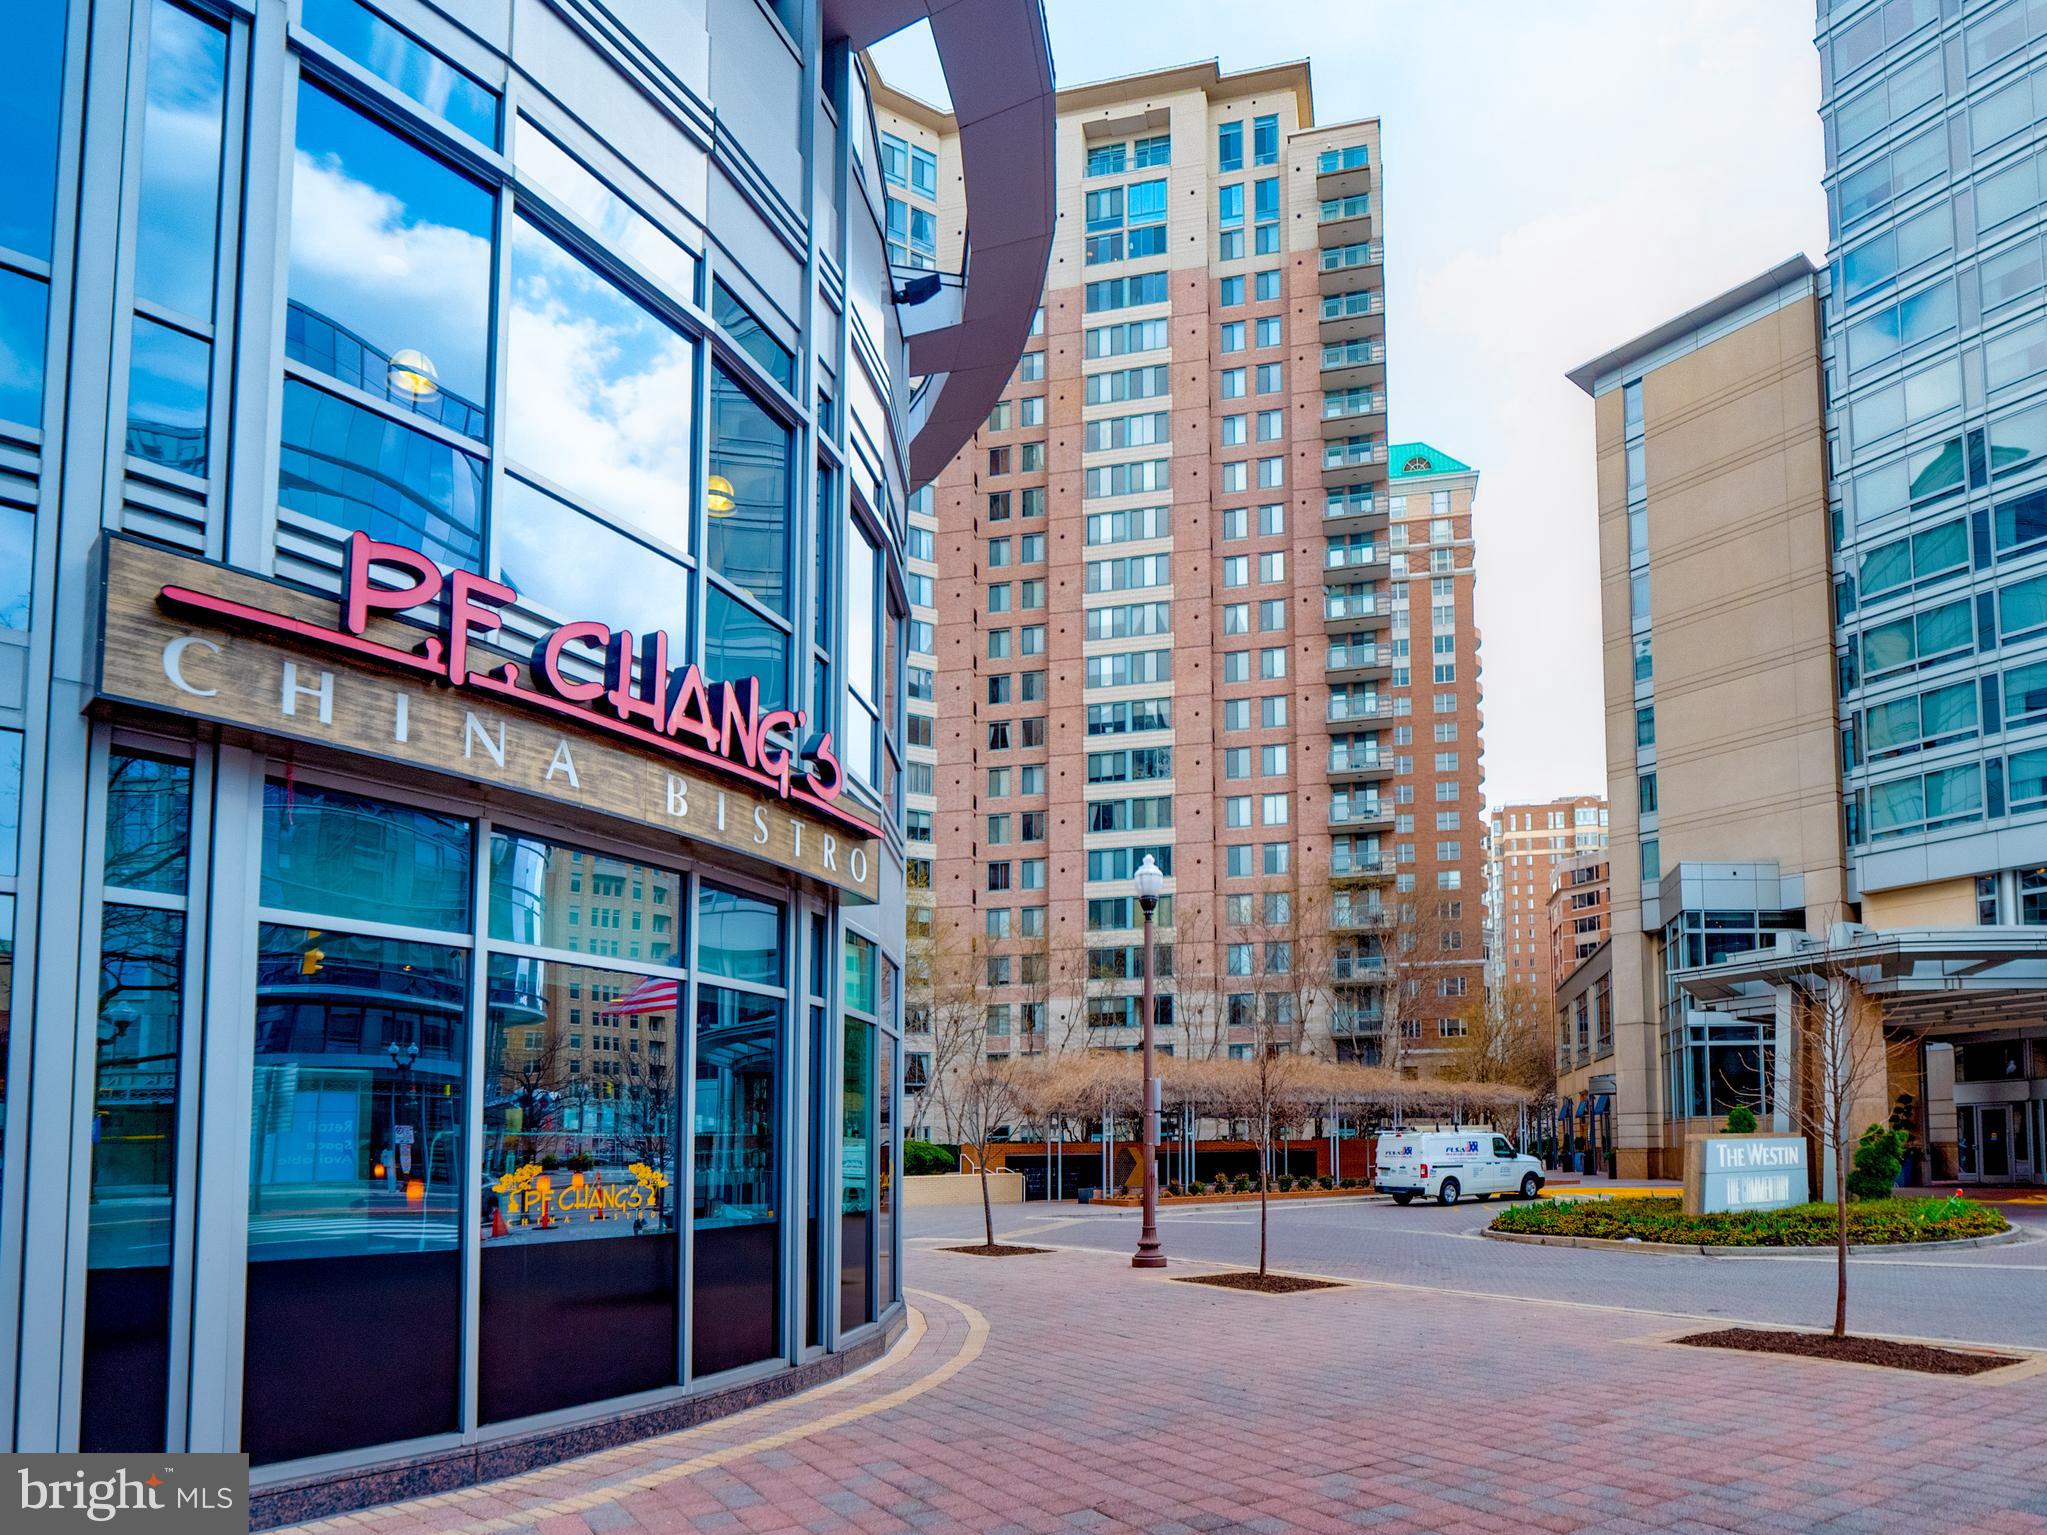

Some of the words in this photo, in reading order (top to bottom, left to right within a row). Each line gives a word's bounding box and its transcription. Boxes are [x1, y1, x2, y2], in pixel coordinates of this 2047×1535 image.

[162, 636, 580, 788] CHINA
[666, 774, 868, 883] BISTRO
[1716, 1143, 1745, 1167] THE
[1746, 1143, 1799, 1165] WESTIN
[506, 1215, 570, 1227] CHINA
[589, 1210, 656, 1222] BISTRO
